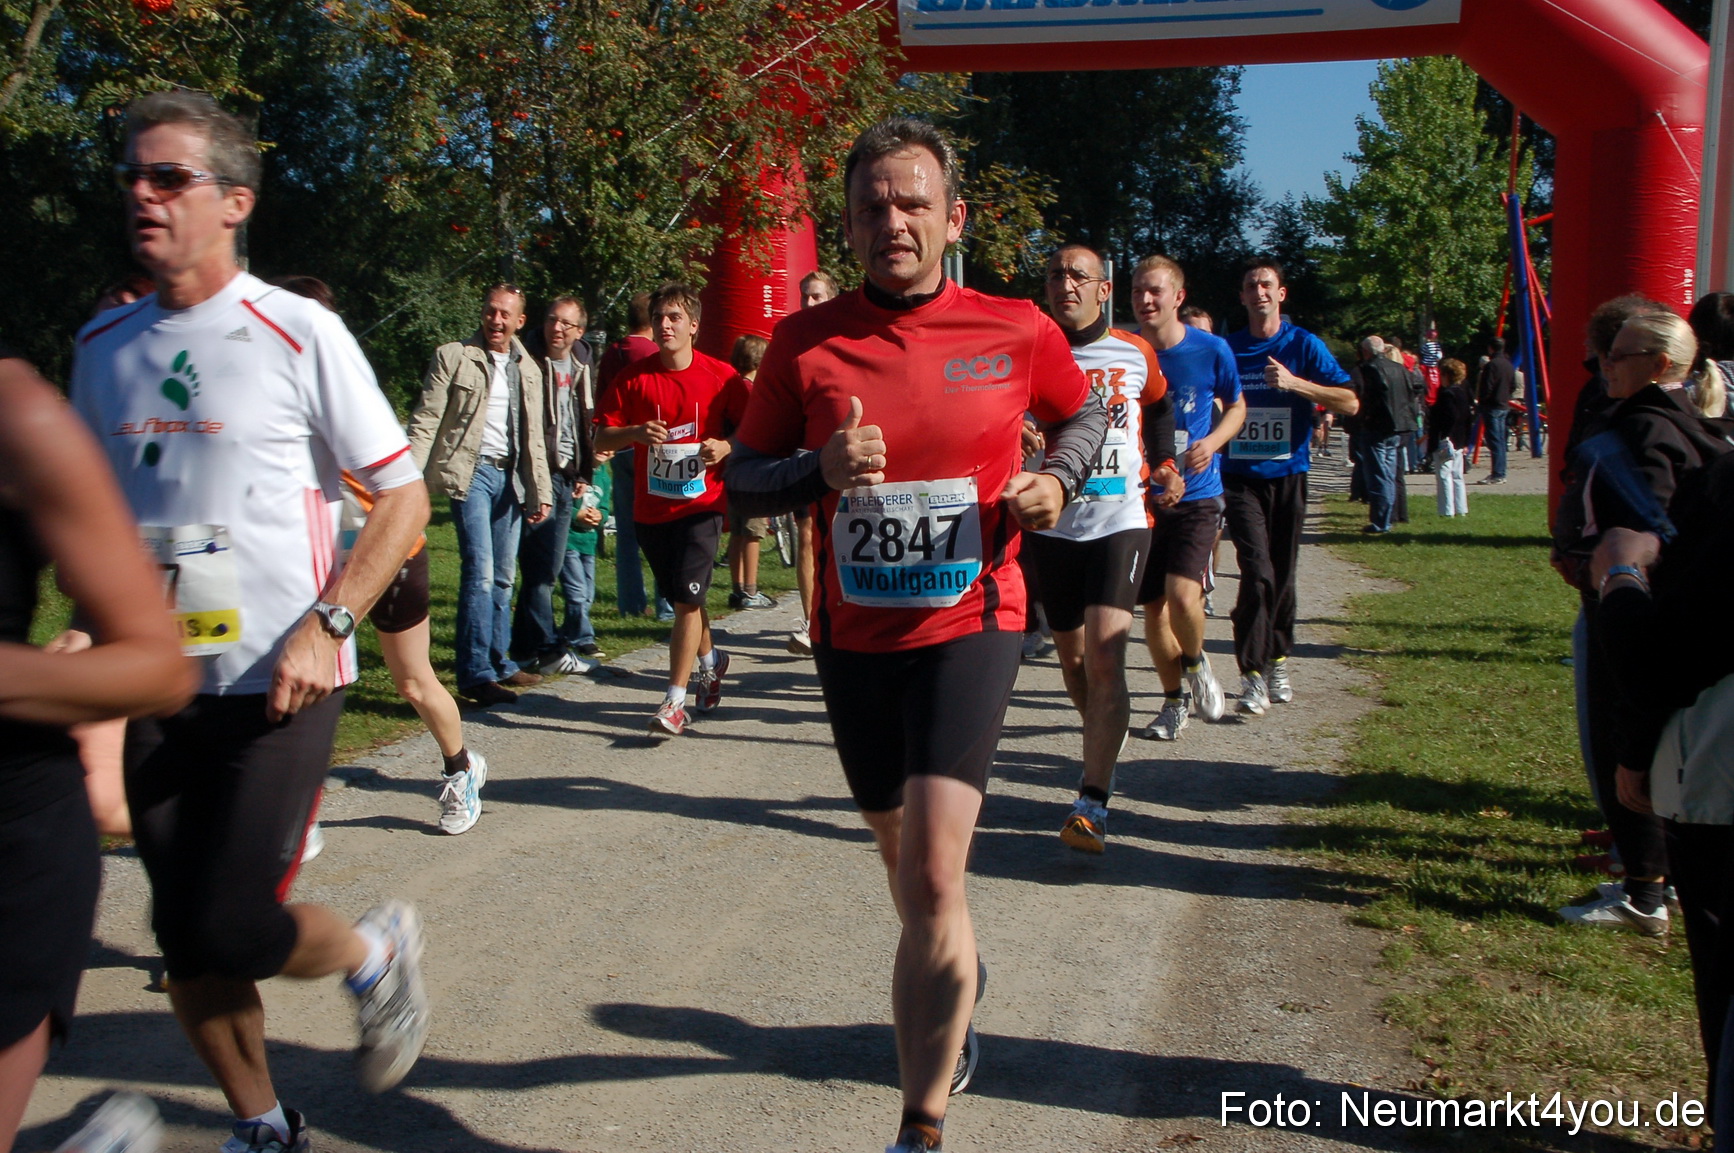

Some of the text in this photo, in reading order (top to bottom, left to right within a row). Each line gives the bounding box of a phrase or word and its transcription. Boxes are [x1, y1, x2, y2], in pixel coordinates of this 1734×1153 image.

[763, 285, 772, 302] 1929
[944, 353, 1013, 382] eco
[1237, 421, 1284, 440] 2616
[1239, 441, 1281, 453] Michael
[653, 457, 699, 479] 2719
[658, 480, 695, 492] Thomas
[850, 493, 914, 508] PFLEIDERER
[848, 514, 963, 562] 2847
[852, 567, 967, 596] Wolfgang
